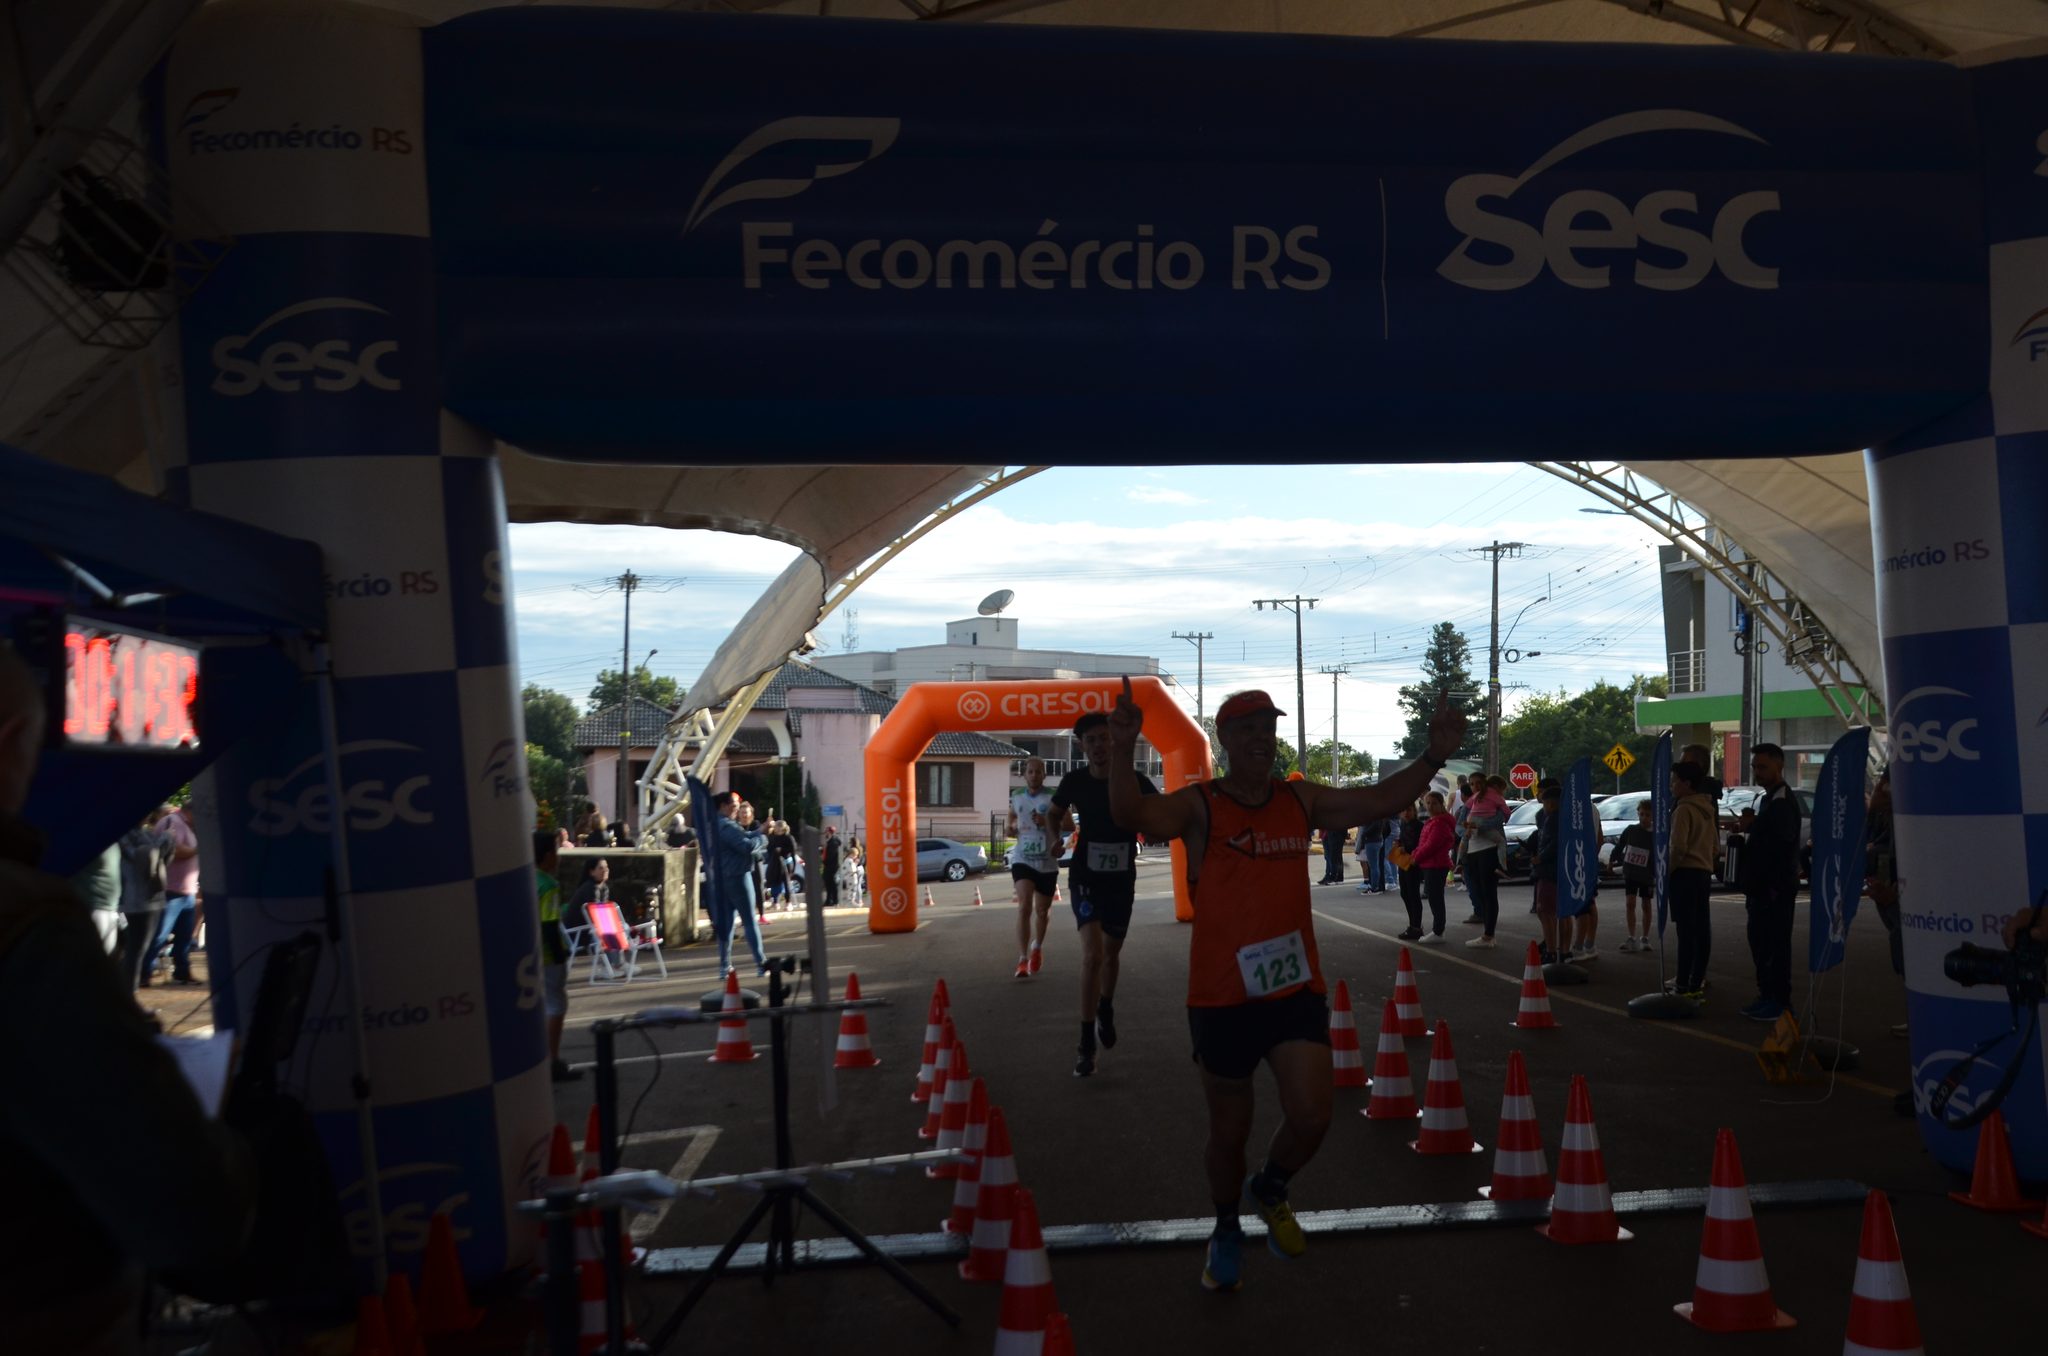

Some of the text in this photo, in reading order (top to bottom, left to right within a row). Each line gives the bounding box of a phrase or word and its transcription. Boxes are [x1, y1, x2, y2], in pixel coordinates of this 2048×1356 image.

[188, 122, 412, 155] Fecomércio RS
[1436, 172, 1782, 291] Sesc
[742, 218, 1332, 290] Fecomércio RS
[210, 334, 401, 396] Sesc
[1954, 538, 1991, 562] RS
[401, 569, 440, 596] RS
[1000, 690, 1118, 717] CRESOL
[1889, 718, 1981, 763] esc
[1511, 772, 1533, 780] PARE
[880, 778, 904, 880] CRESOL
[1023, 842, 1042, 853] 241
[1099, 854, 1119, 869] 79
[1571, 839, 1586, 901] Sesc
[1254, 952, 1301, 992] 123
[437, 992, 474, 1020] RS
